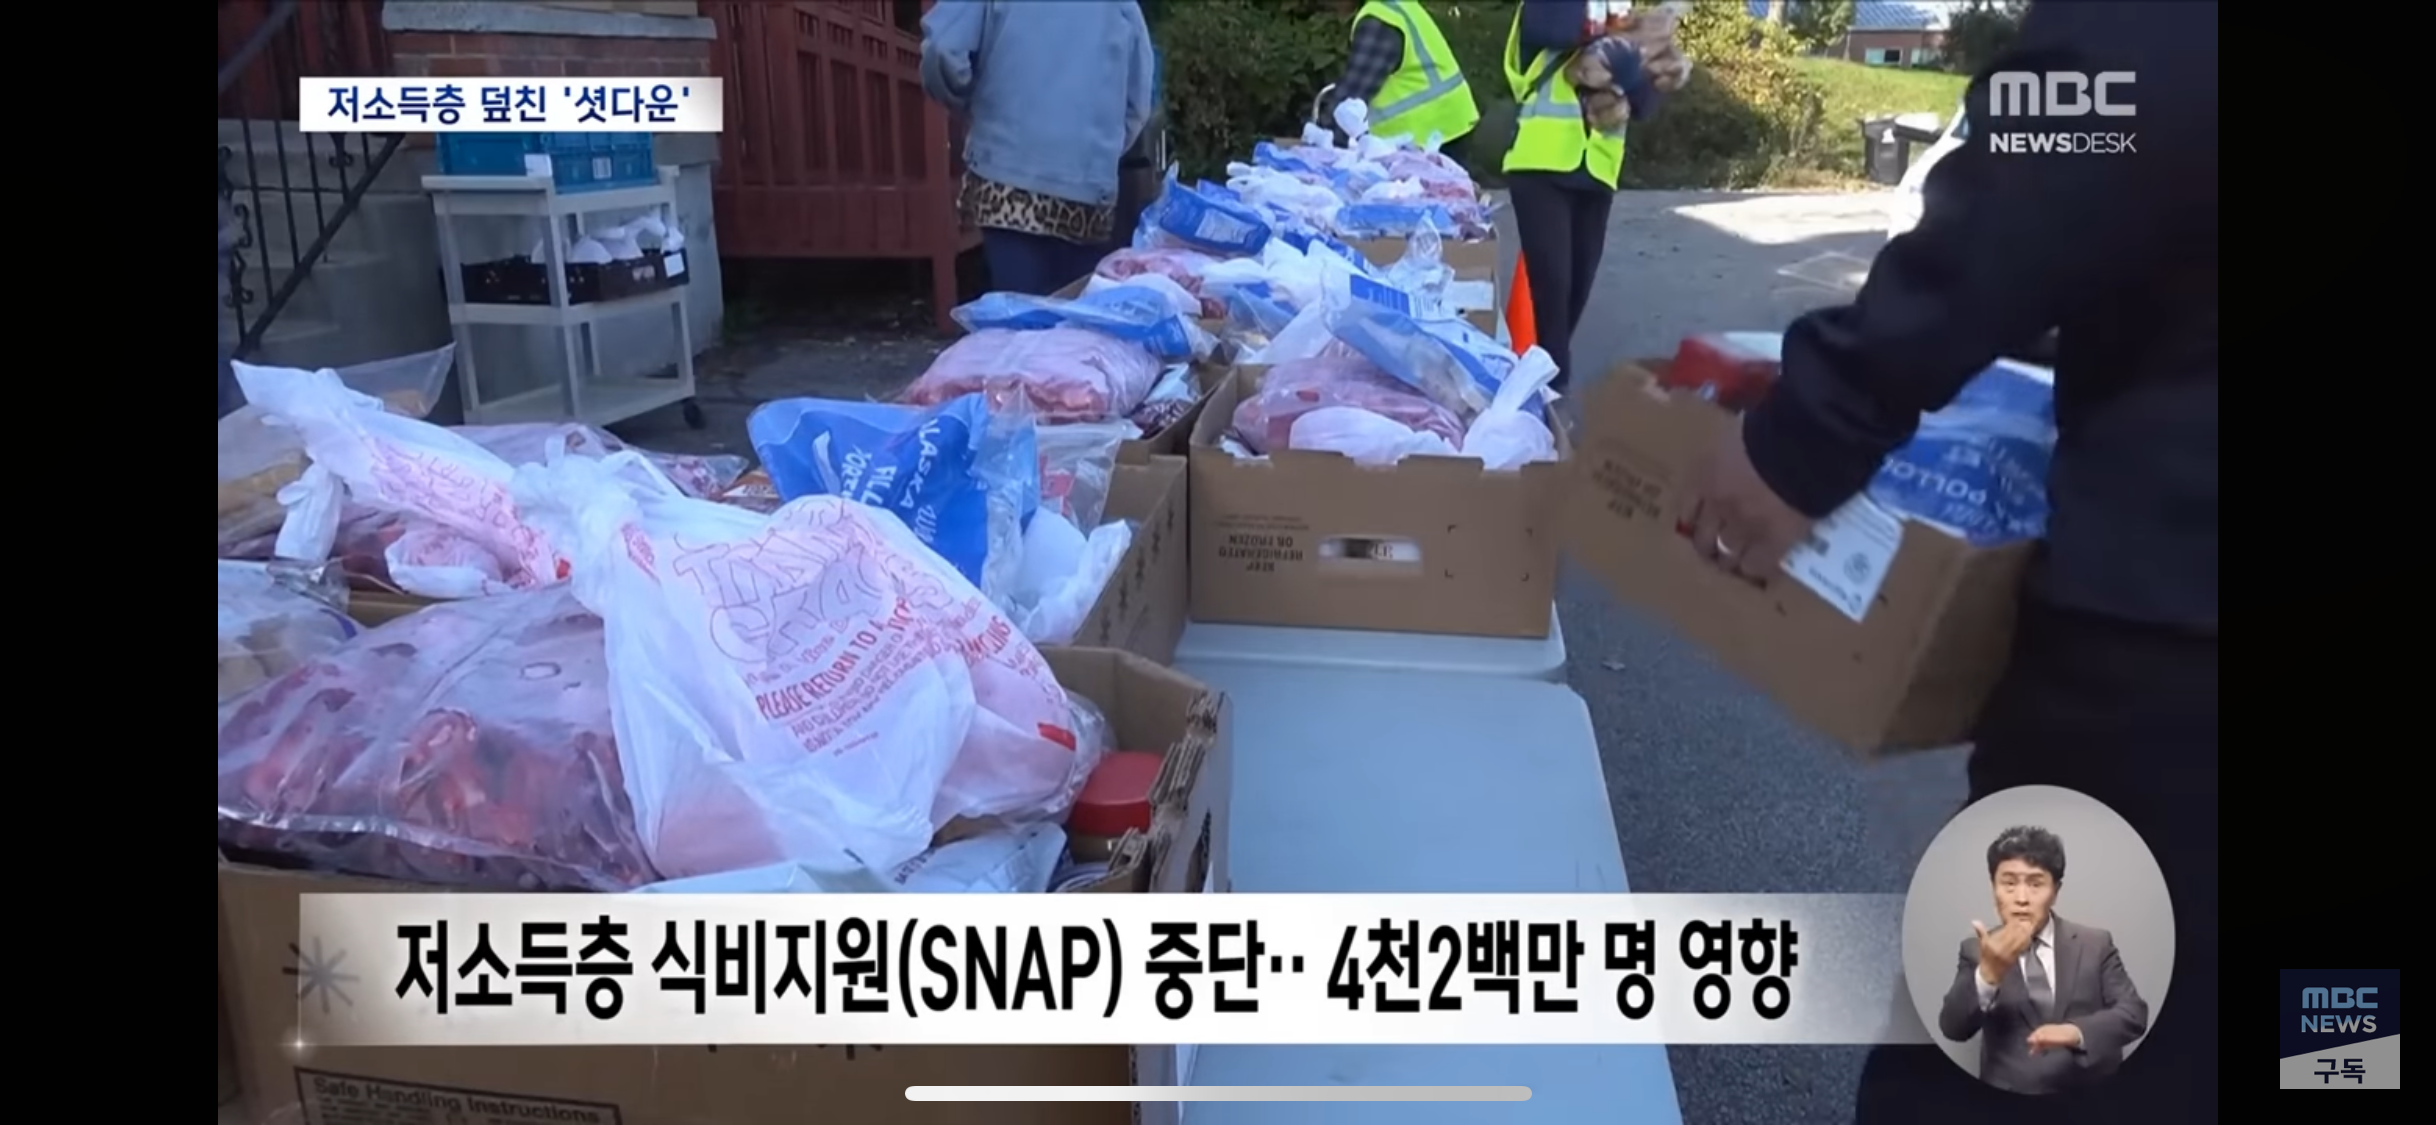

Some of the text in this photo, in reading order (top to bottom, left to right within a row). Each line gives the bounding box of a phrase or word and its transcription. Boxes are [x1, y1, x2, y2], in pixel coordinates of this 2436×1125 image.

[754, 683, 813, 721] PLEASE
[801, 650, 861, 700] RETURN
[849, 630, 878, 651] TO
[313, 1076, 360, 1099] Safe
[366, 1083, 462, 1113] Handling
[467, 1094, 601, 1123] Instructions
